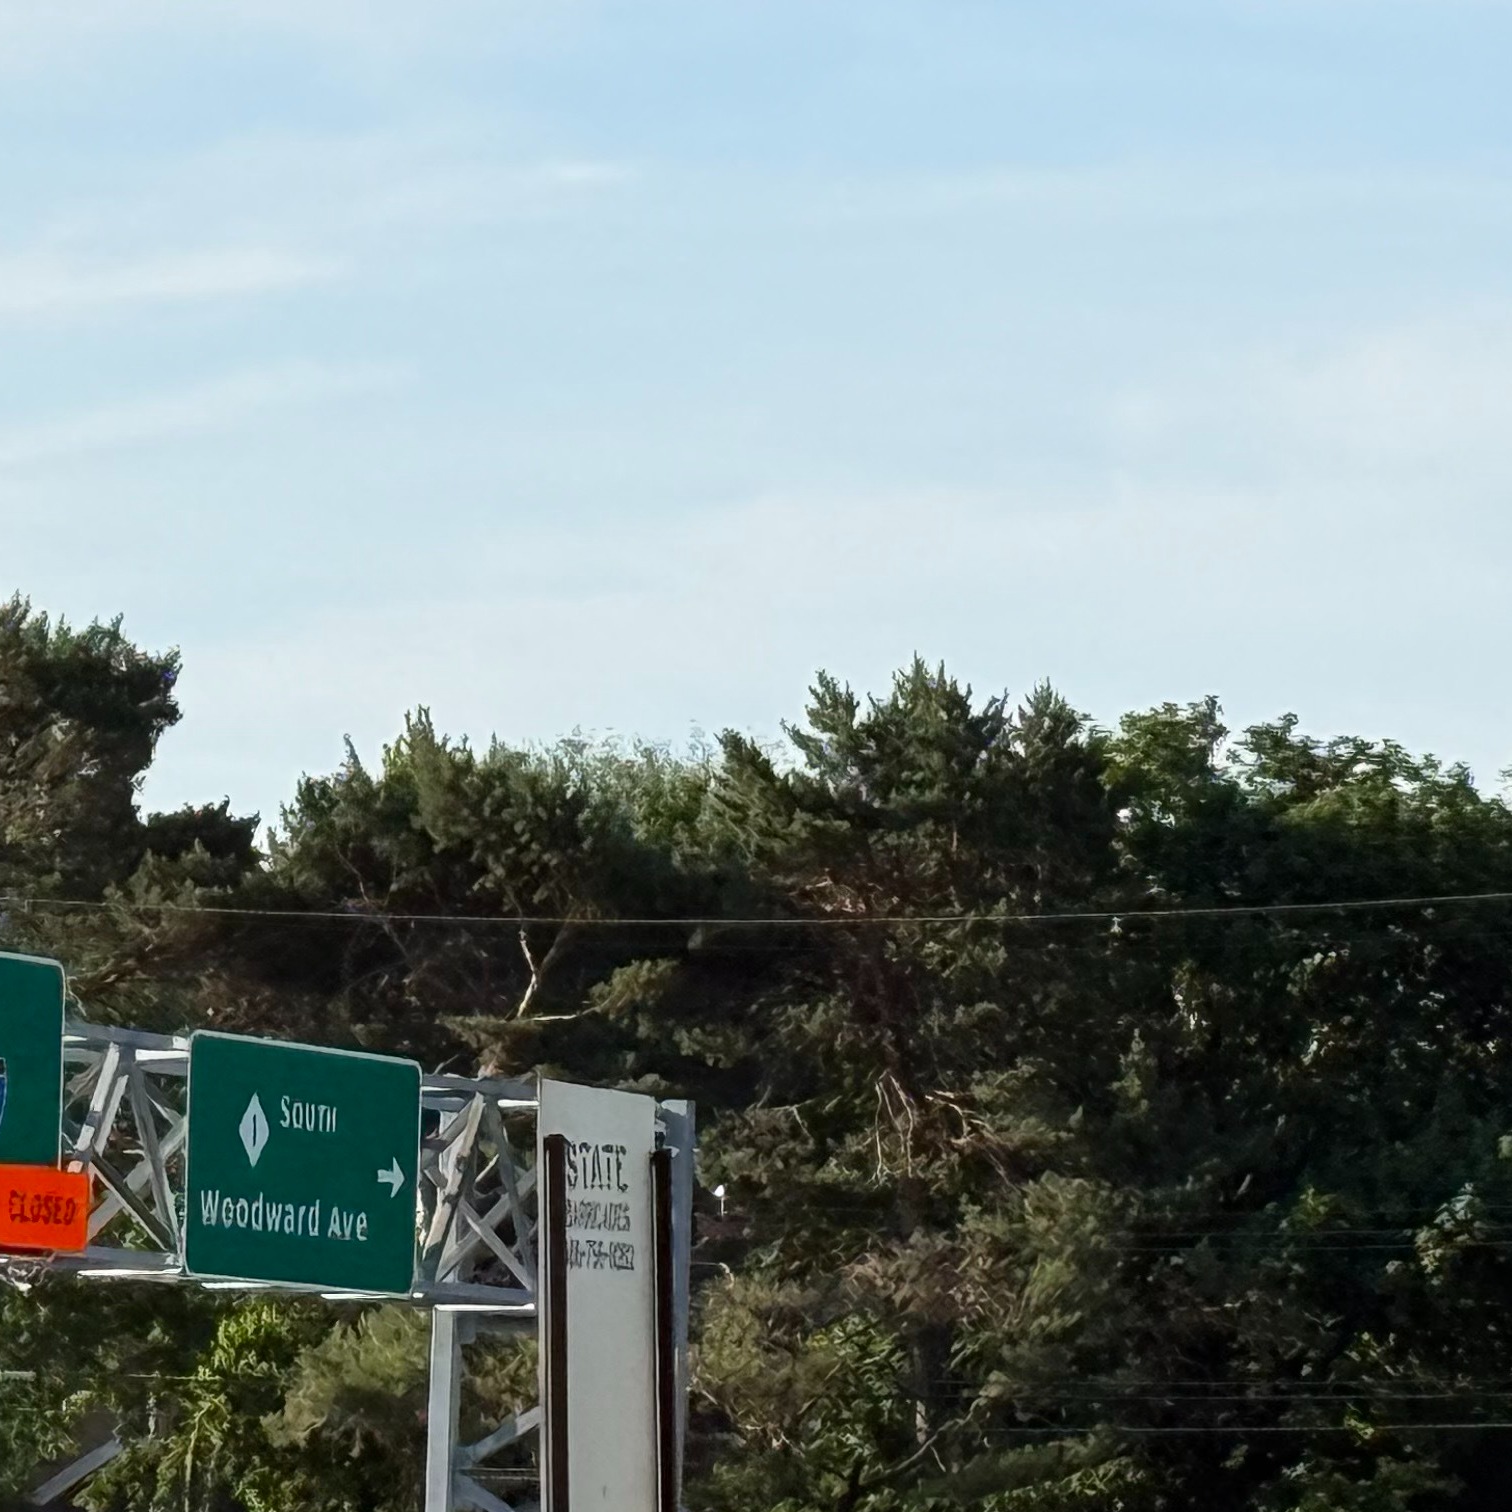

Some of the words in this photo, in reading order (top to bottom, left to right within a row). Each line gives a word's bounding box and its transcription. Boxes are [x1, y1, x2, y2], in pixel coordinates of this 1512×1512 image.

[567, 1141, 629, 1192] STATE
[8, 1189, 77, 1226] CLOSED
[200, 1189, 320, 1237] Woodward
[328, 1206, 369, 1242] Ave
